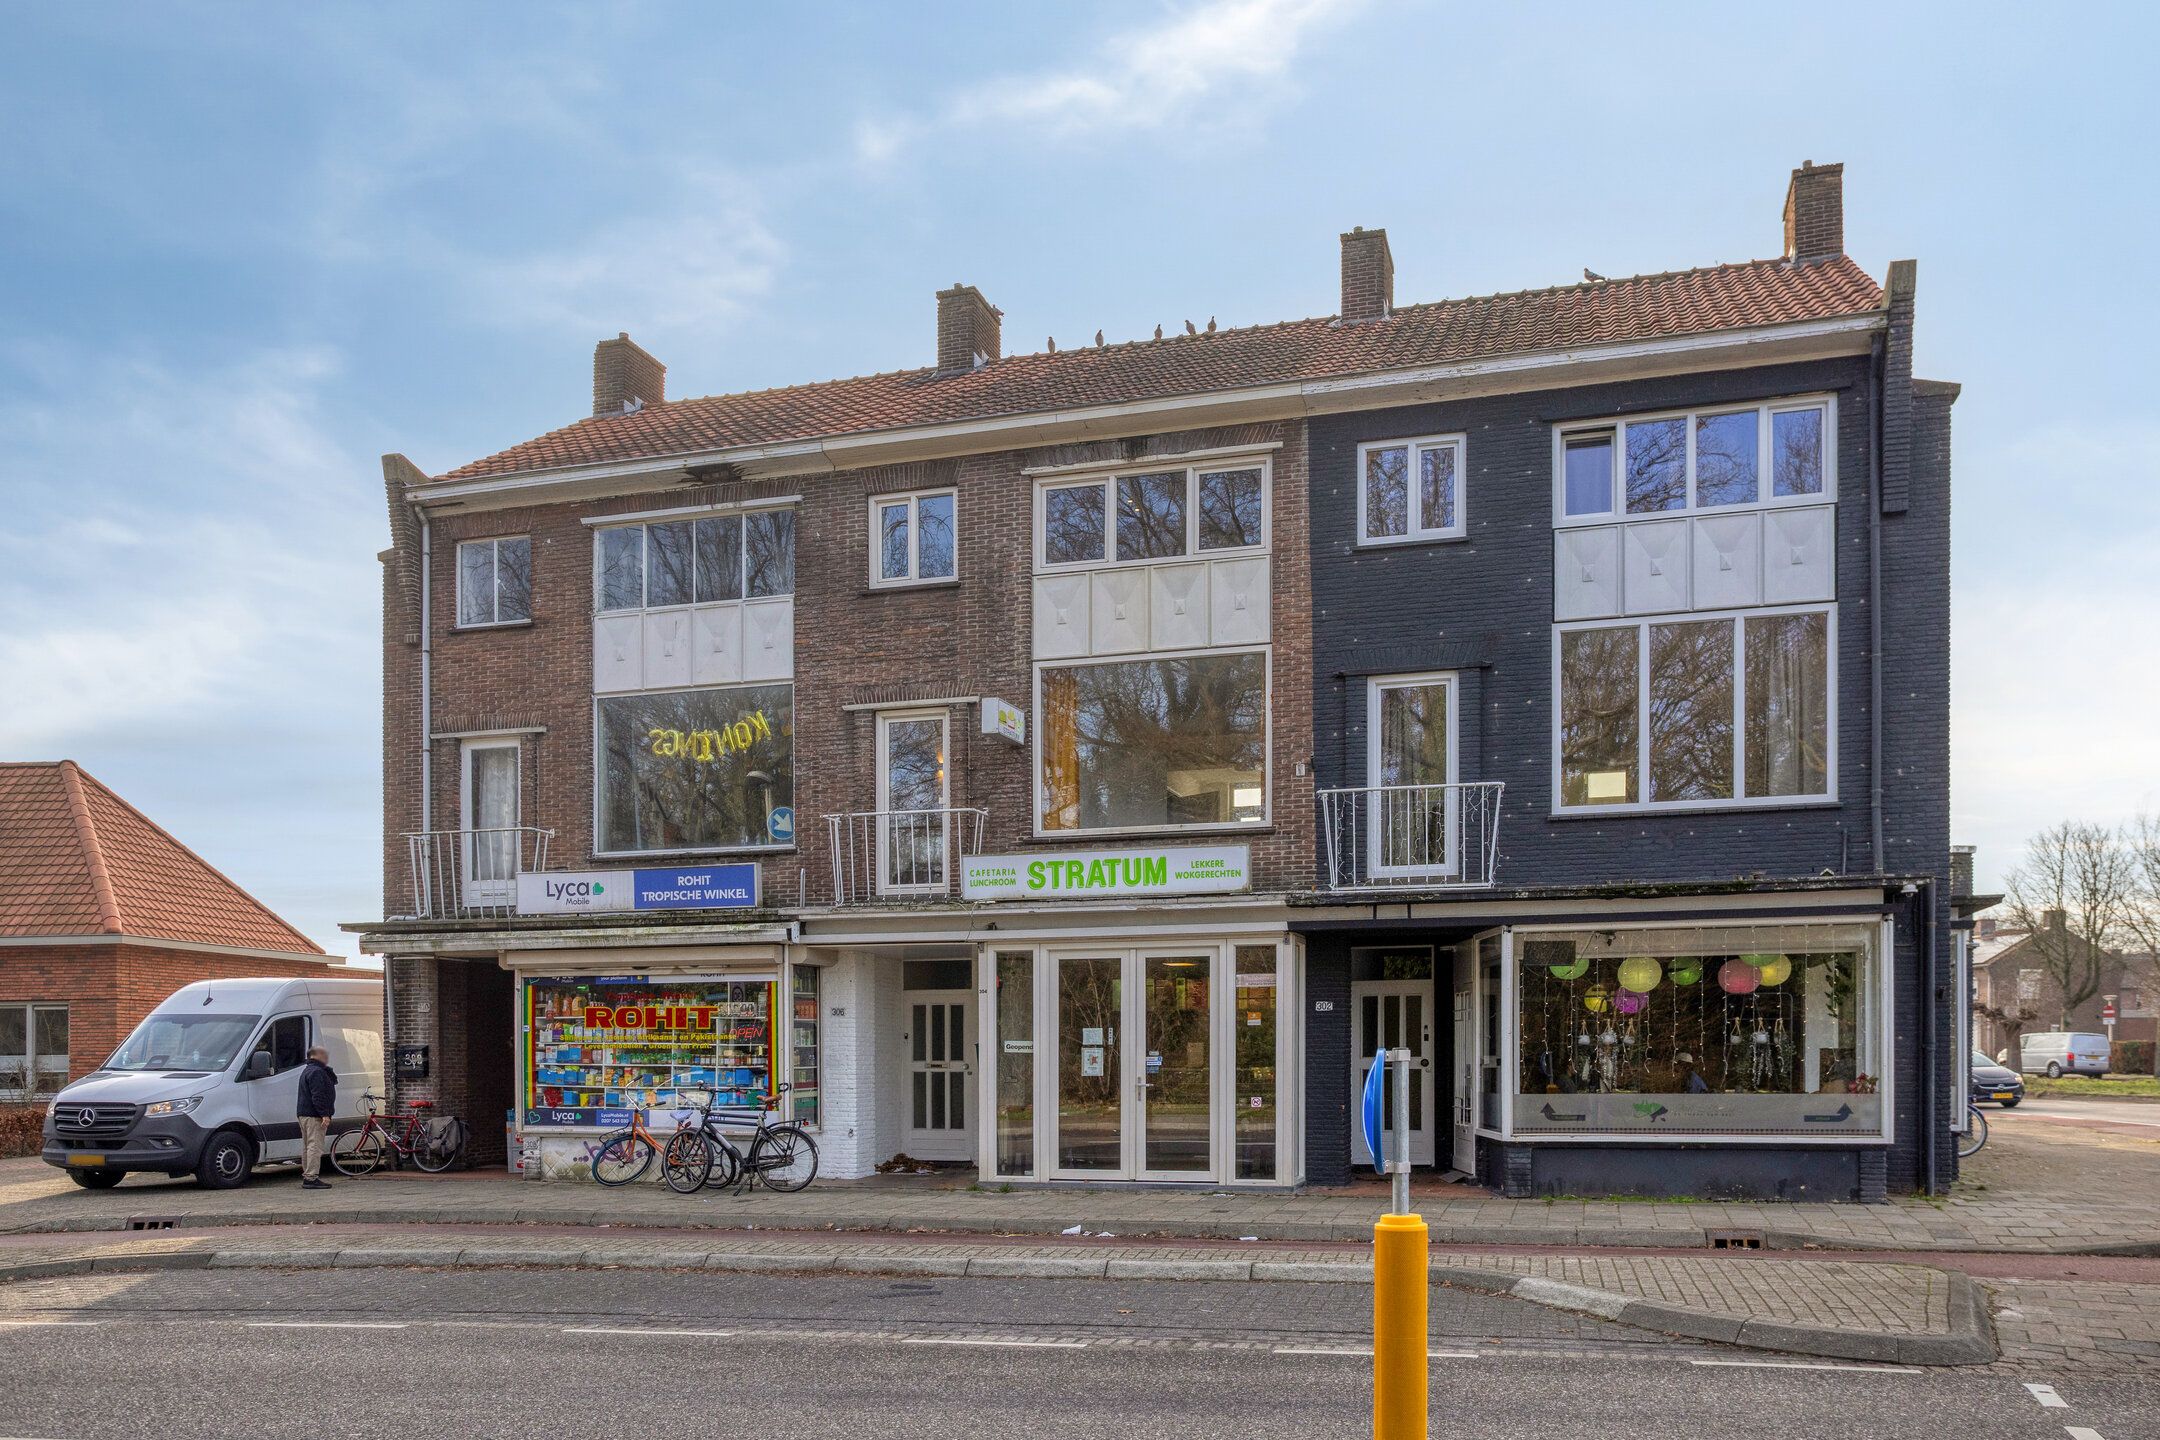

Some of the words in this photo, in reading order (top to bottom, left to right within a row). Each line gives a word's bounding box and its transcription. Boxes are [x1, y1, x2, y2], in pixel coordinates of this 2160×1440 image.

[1190, 859, 1225, 869] LEKKERE
[969, 868, 1016, 877] CAFETARIA
[1027, 857, 1167, 890] STRATUM
[1174, 869, 1241, 880] WOKGERECHTEN
[677, 875, 711, 886] ROHIT
[969, 878, 1016, 888] LUNCHROOM
[546, 880, 590, 900] Lyca
[642, 890, 702, 901] TROPISCHE
[703, 888, 748, 899] WINKEL
[1316, 1002, 1333, 1011] 302
[584, 1006, 718, 1029] ROHIT
[730, 1026, 763, 1039] OPEN
[1006, 1043, 1033, 1051] Geopend
[552, 1111, 575, 1121] Lyca
